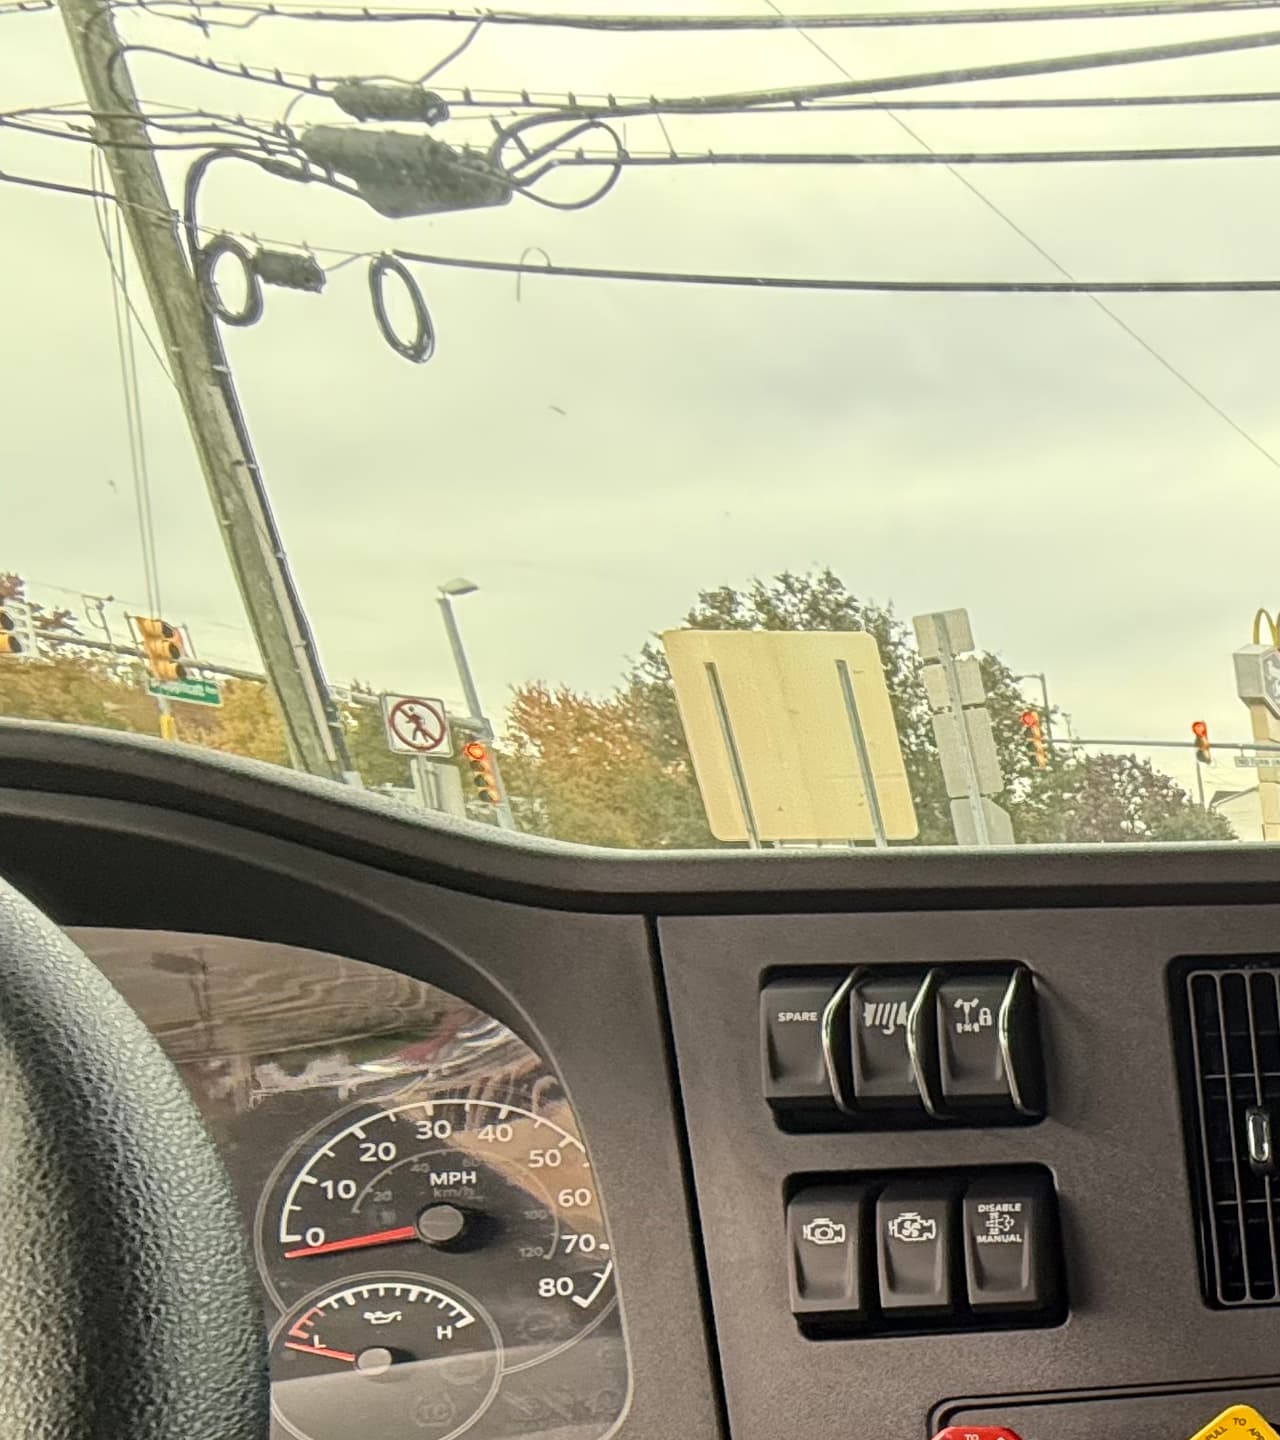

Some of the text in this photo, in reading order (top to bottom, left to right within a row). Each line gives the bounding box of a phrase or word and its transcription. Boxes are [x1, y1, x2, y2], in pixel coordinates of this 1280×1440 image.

[778, 1012, 818, 1022] SPARE
[415, 1119, 452, 1140] 30
[478, 1123, 514, 1143] 40
[359, 1140, 397, 1162] 20
[528, 1148, 563, 1168] 50
[429, 1171, 477, 1186] MPH
[320, 1178, 357, 1200] 10
[559, 1187, 592, 1207] 60
[977, 1203, 1022, 1212] DISABLE
[305, 1226, 326, 1246] 0
[561, 1233, 596, 1253] 70
[976, 1234, 1022, 1243] MANUAL
[538, 1277, 574, 1297] 80
[314, 1334, 327, 1348] L
[437, 1325, 453, 1340] H
[1233, 1417, 1247, 1426] TO
